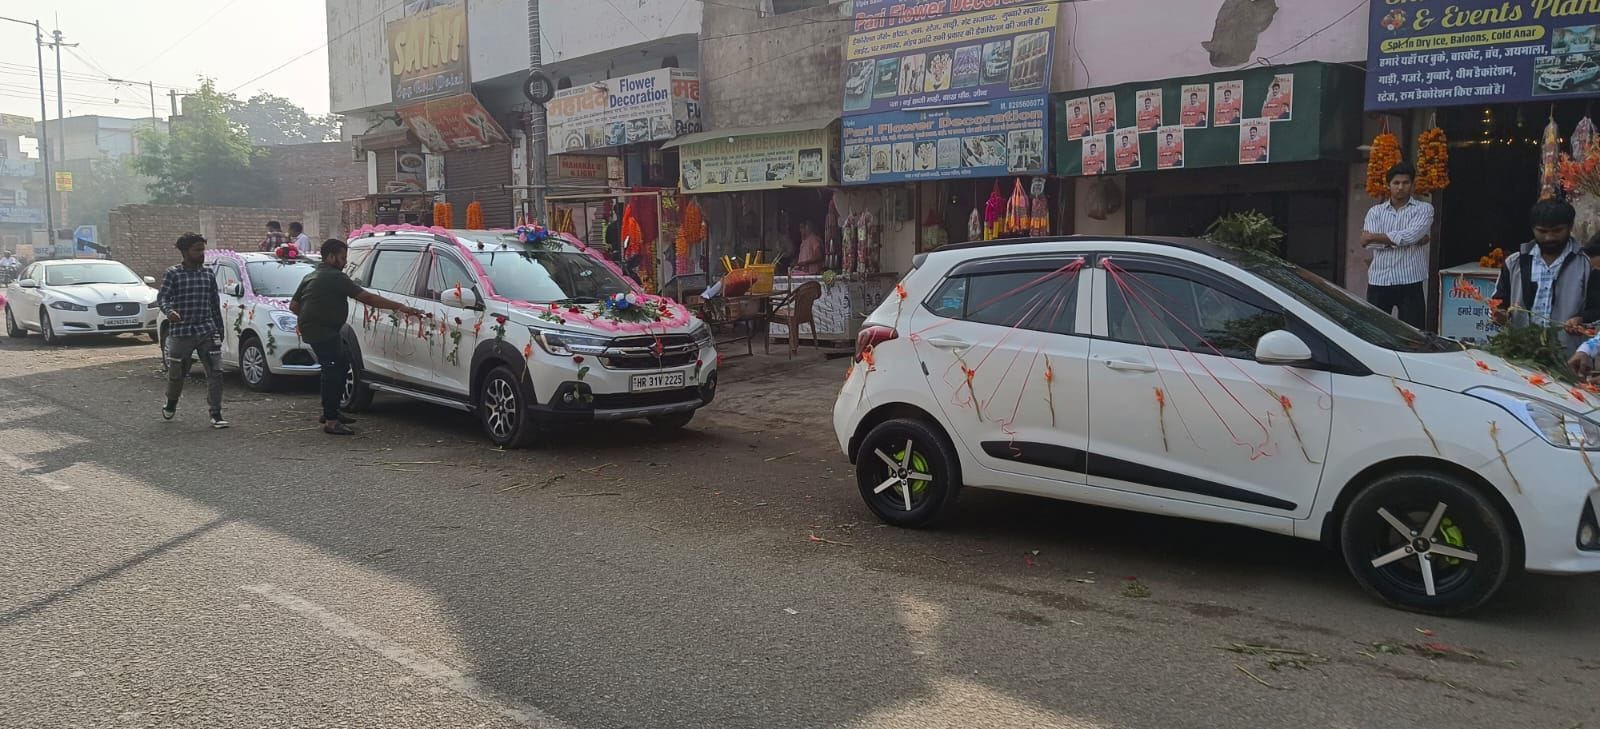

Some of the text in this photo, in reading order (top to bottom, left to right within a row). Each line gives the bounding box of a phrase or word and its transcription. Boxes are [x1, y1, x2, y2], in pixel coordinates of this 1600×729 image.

[854, 8, 886, 32] Pari
[888, 0, 947, 26] Flower
[1412, 0, 1600, 31] & Events Plan
[393, 12, 462, 76] SAINI
[1416, 38, 1431, 49] Dry
[1433, 36, 1448, 46] Ice,
[1451, 31, 1489, 45] Baloons,
[1491, 30, 1511, 40] Cold
[1513, 29, 1537, 38] Anar
[1379, 55, 1399, 67] हमारे
[1418, 54, 1429, 64] पर
[1504, 45, 1549, 57] जयमाला,
[619, 77, 656, 93] Flower
[1378, 73, 1400, 86] गाड़ी,
[1401, 70, 1424, 83] गजरे,
[1456, 67, 1473, 79] थीम
[609, 88, 668, 108] Decoration
[1377, 90, 1398, 102] स्टेज,
[1453, 85, 1473, 97] किए
[1474, 83, 1493, 95] जाते
[843, 125, 874, 138] Pari
[877, 120, 935, 135] Flower
[938, 109, 1043, 129] Decoration
[755, 131, 823, 150] DECORATION
[577, 169, 597, 177] LIGHT
[637, 374, 682, 388] HR 31V 2225
